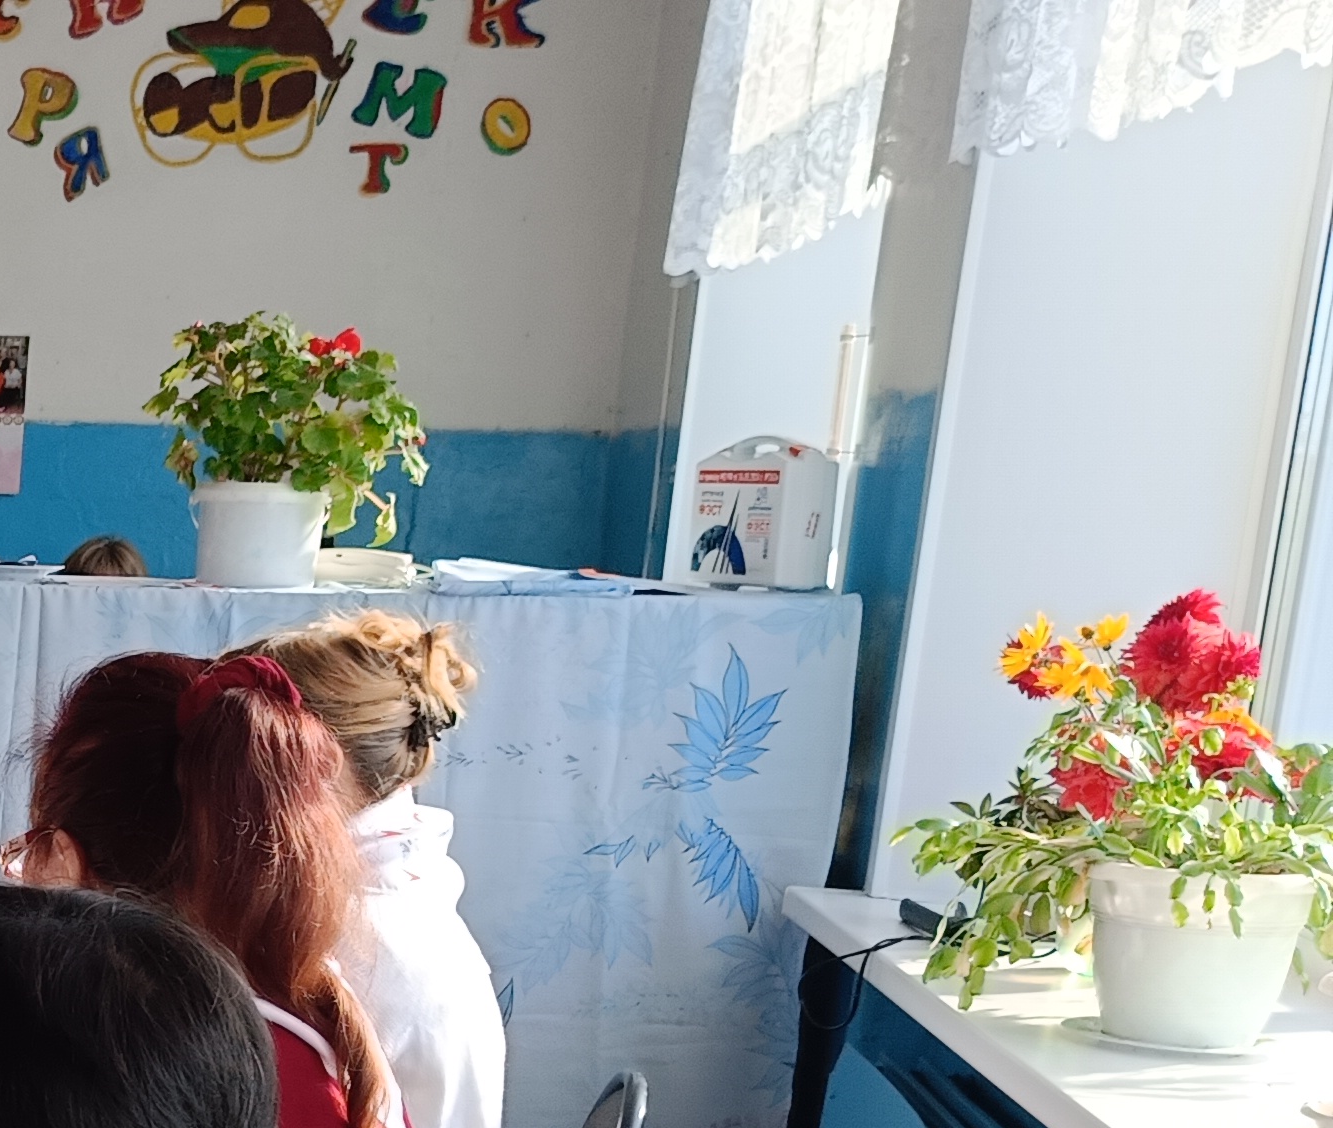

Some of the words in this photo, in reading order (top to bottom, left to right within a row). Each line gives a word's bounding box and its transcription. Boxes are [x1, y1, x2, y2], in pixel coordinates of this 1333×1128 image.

[7, 68, 79, 146] Р
[351, 61, 448, 139] М
[481, 97, 531, 156] О
[54, 127, 110, 202] Я
[349, 143, 409, 197] Т
